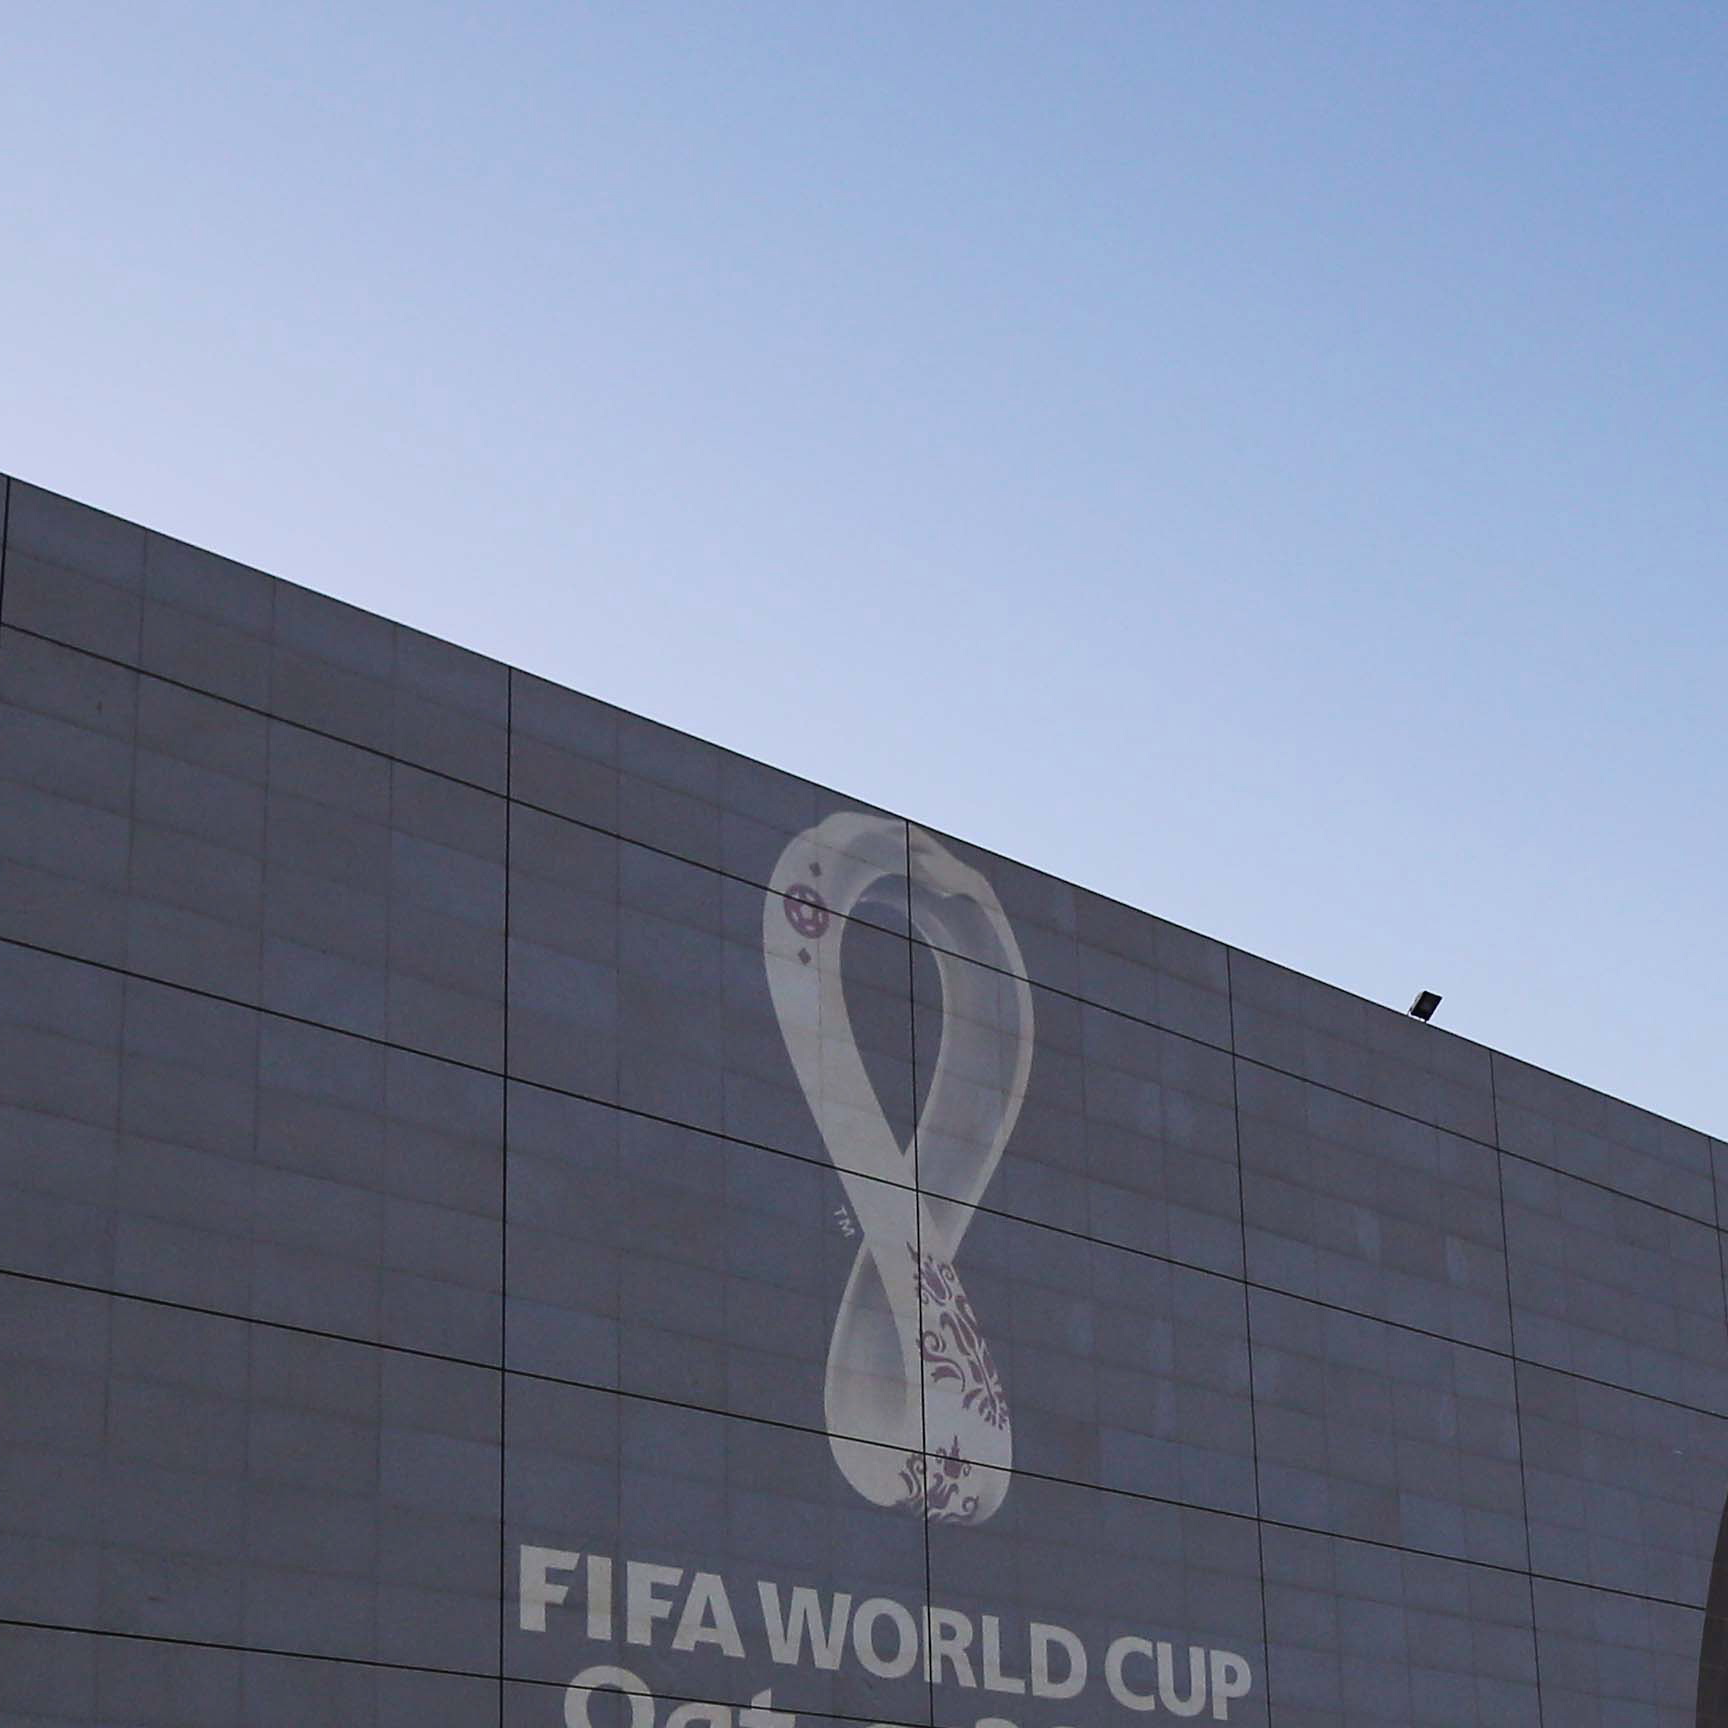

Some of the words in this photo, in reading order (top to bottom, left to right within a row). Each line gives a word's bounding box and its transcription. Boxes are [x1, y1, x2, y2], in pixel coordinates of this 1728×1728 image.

[834, 1204, 855, 1239] TM
[519, 1544, 746, 1660] FIFA
[757, 1579, 1089, 1700] WORLD
[1104, 1635, 1253, 1721] CUP
